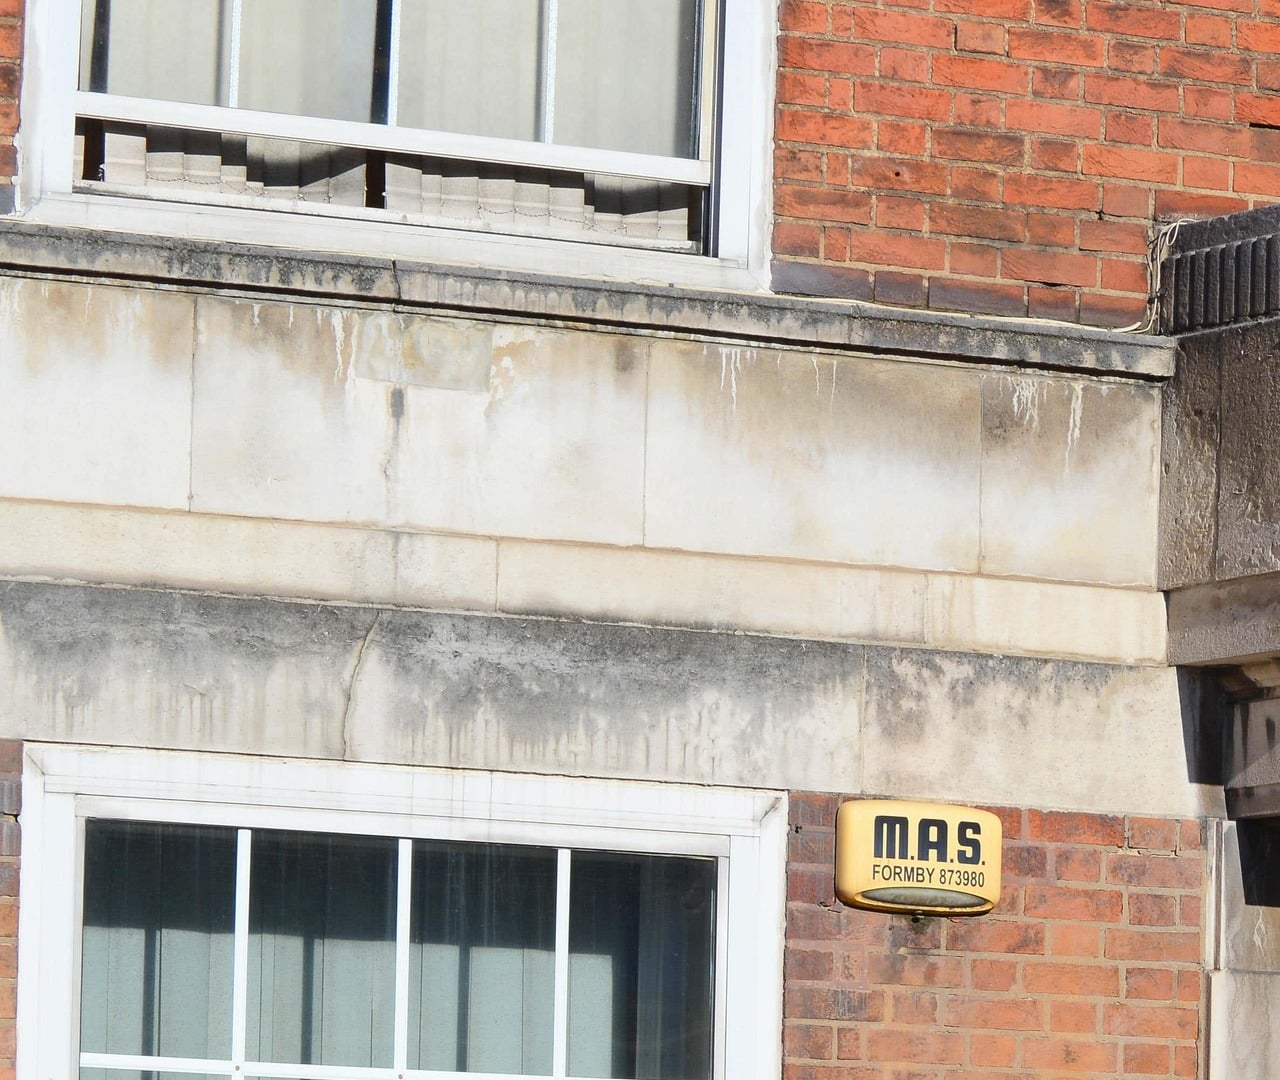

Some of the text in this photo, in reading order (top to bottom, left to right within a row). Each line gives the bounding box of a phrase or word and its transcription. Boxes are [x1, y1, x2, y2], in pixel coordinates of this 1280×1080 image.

[873, 815, 985, 866] M.A.S.
[872, 864, 985, 888] FORMBY 873980
